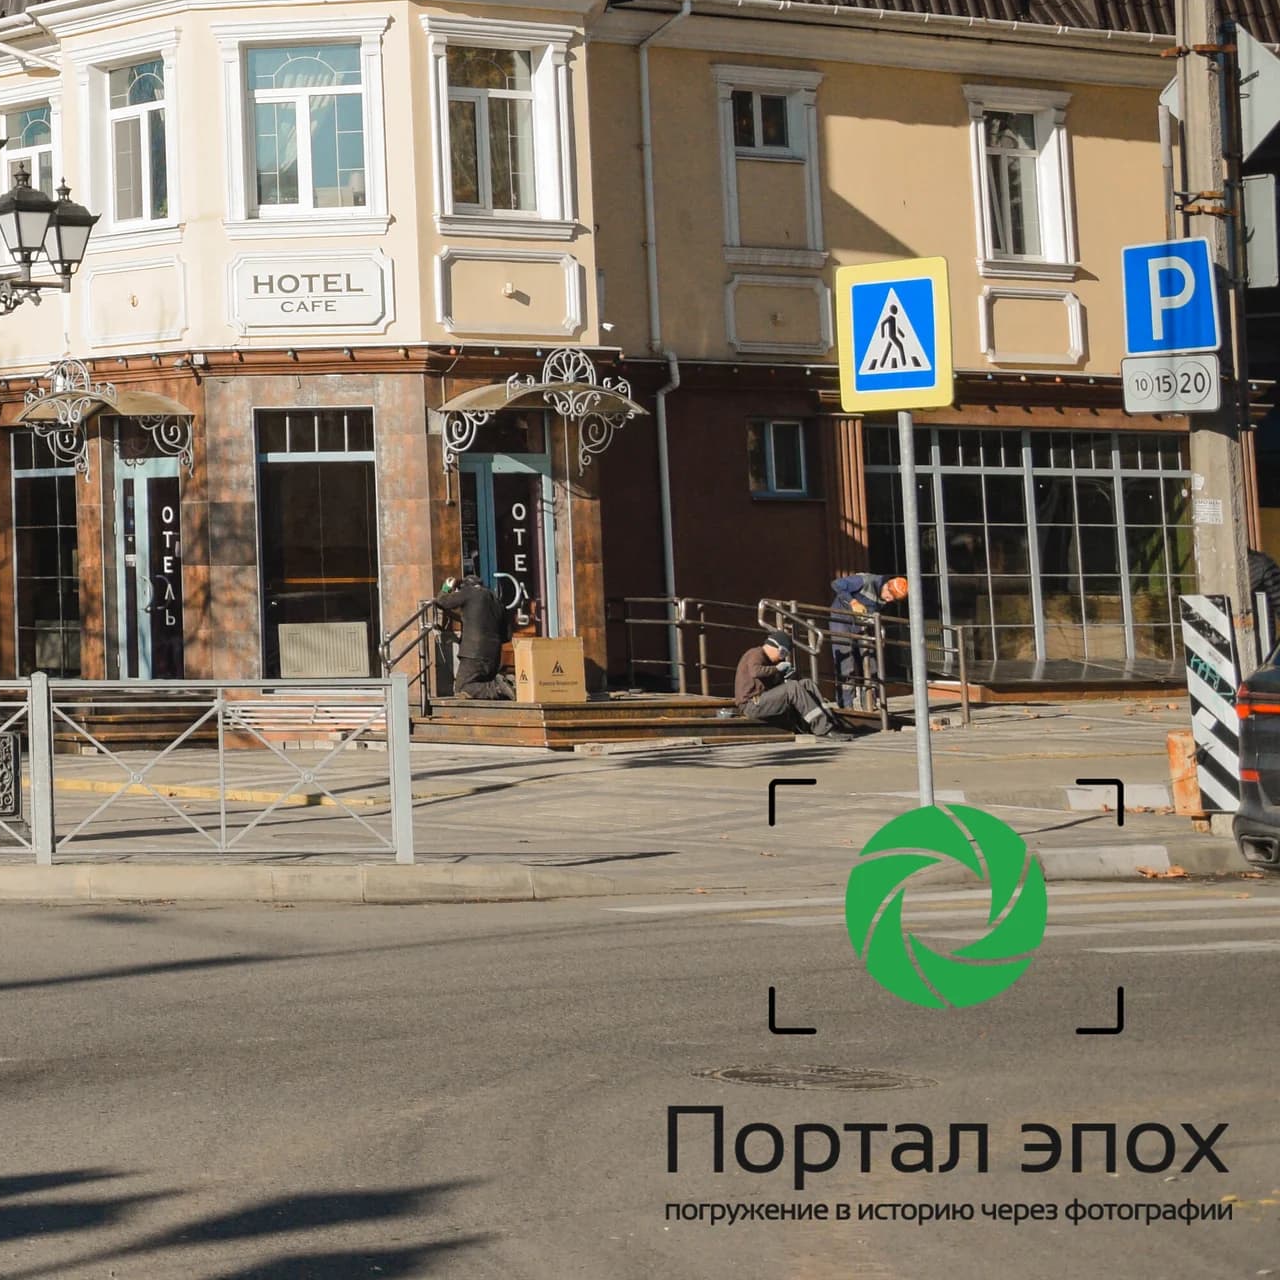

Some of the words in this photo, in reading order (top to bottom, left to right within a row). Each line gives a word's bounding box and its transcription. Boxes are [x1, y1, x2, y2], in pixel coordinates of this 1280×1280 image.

[253, 273, 364, 294] HOTEL
[281, 300, 336, 313] CAFE
[1148, 256, 1196, 341] P
[1135, 378, 1148, 391] 10
[1155, 375, 1172, 393] 15
[1180, 372, 1205, 393] 20
[161, 506, 176, 626] ОТЕЛЬ
